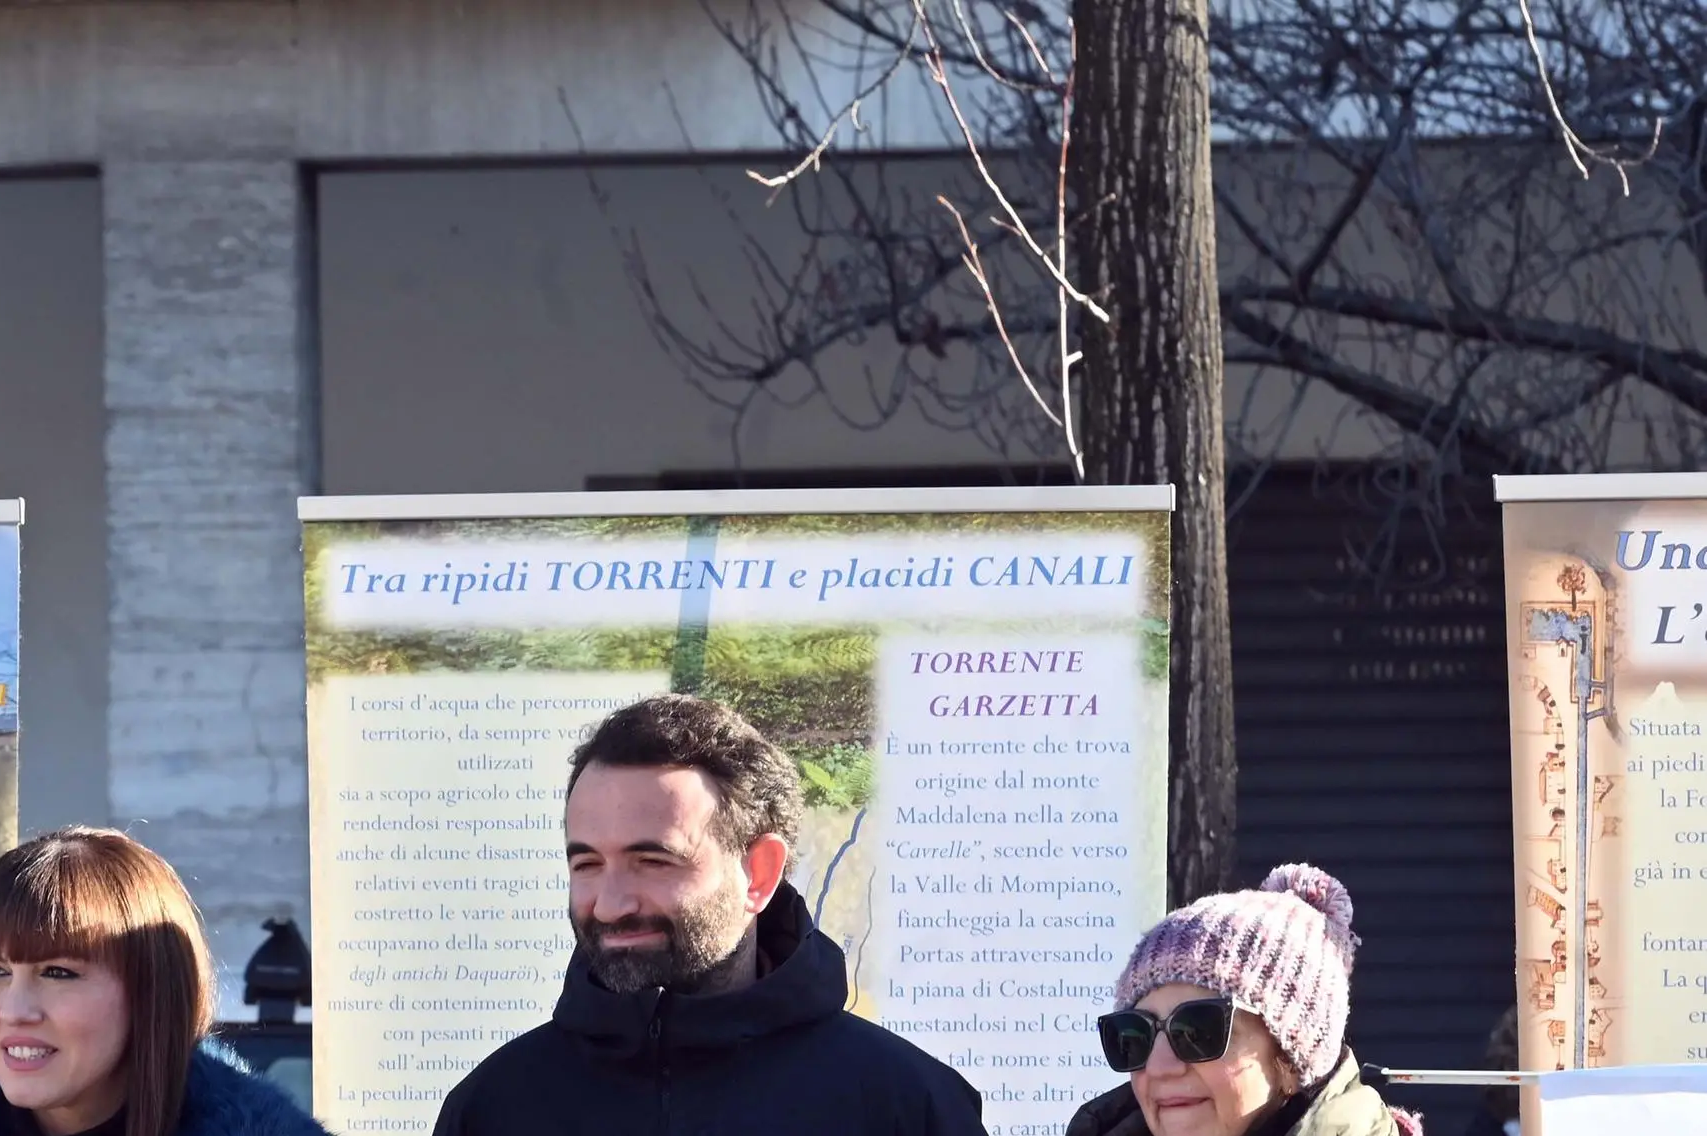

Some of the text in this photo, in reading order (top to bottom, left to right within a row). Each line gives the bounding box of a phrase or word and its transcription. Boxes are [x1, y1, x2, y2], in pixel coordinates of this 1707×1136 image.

[340, 554, 1135, 606] Tra ripidi TORRENTI e placidi CANALI
[910, 651, 1084, 674] TORRENTE
[361, 697, 404, 712] corsi
[485, 694, 516, 711] che
[522, 697, 625, 716] percorrono
[929, 694, 1099, 717] GARZETTA
[361, 727, 452, 744] territorio,
[458, 725, 480, 741] da
[485, 728, 550, 746] sempre
[1629, 718, 1701, 736] Situata
[907, 735, 1131, 754] un torrente che trova
[457, 754, 533, 771] utilizzati
[1652, 752, 1704, 780] piedi
[915, 770, 1100, 797] origine dal monte
[380, 783, 546, 806] scopo agricolo che
[896, 804, 1118, 824] Maddalena nella zona
[343, 814, 552, 836] rendendosi responsabili
[335, 843, 564, 862] anche di alcune disastrose
[993, 839, 1064, 858] scende
[1072, 845, 1128, 858] verso
[1634, 861, 1663, 887] già
[354, 874, 540, 897] relativi eventi tragici
[915, 874, 1122, 899] Valle di Mompiano,
[354, 904, 505, 921] costretto le varie
[897, 909, 1116, 935] fiancheggia cascina
[338, 934, 488, 956] occupavano della
[900, 944, 1113, 963] Portas attraversando
[349, 965, 386, 986] degli
[393, 965, 448, 981] antichi
[1663, 969, 1687, 988] La
[912, 978, 1115, 1006] piana di Costalunga
[327, 996, 543, 1013] misure contenimento,
[1014, 1014, 1044, 1032] nel
[383, 1026, 483, 1047] con pesanti
[948, 1049, 1050, 1067] tale nome
[1032, 1083, 1074, 1101] altri
[347, 1117, 427, 1131] territorio
